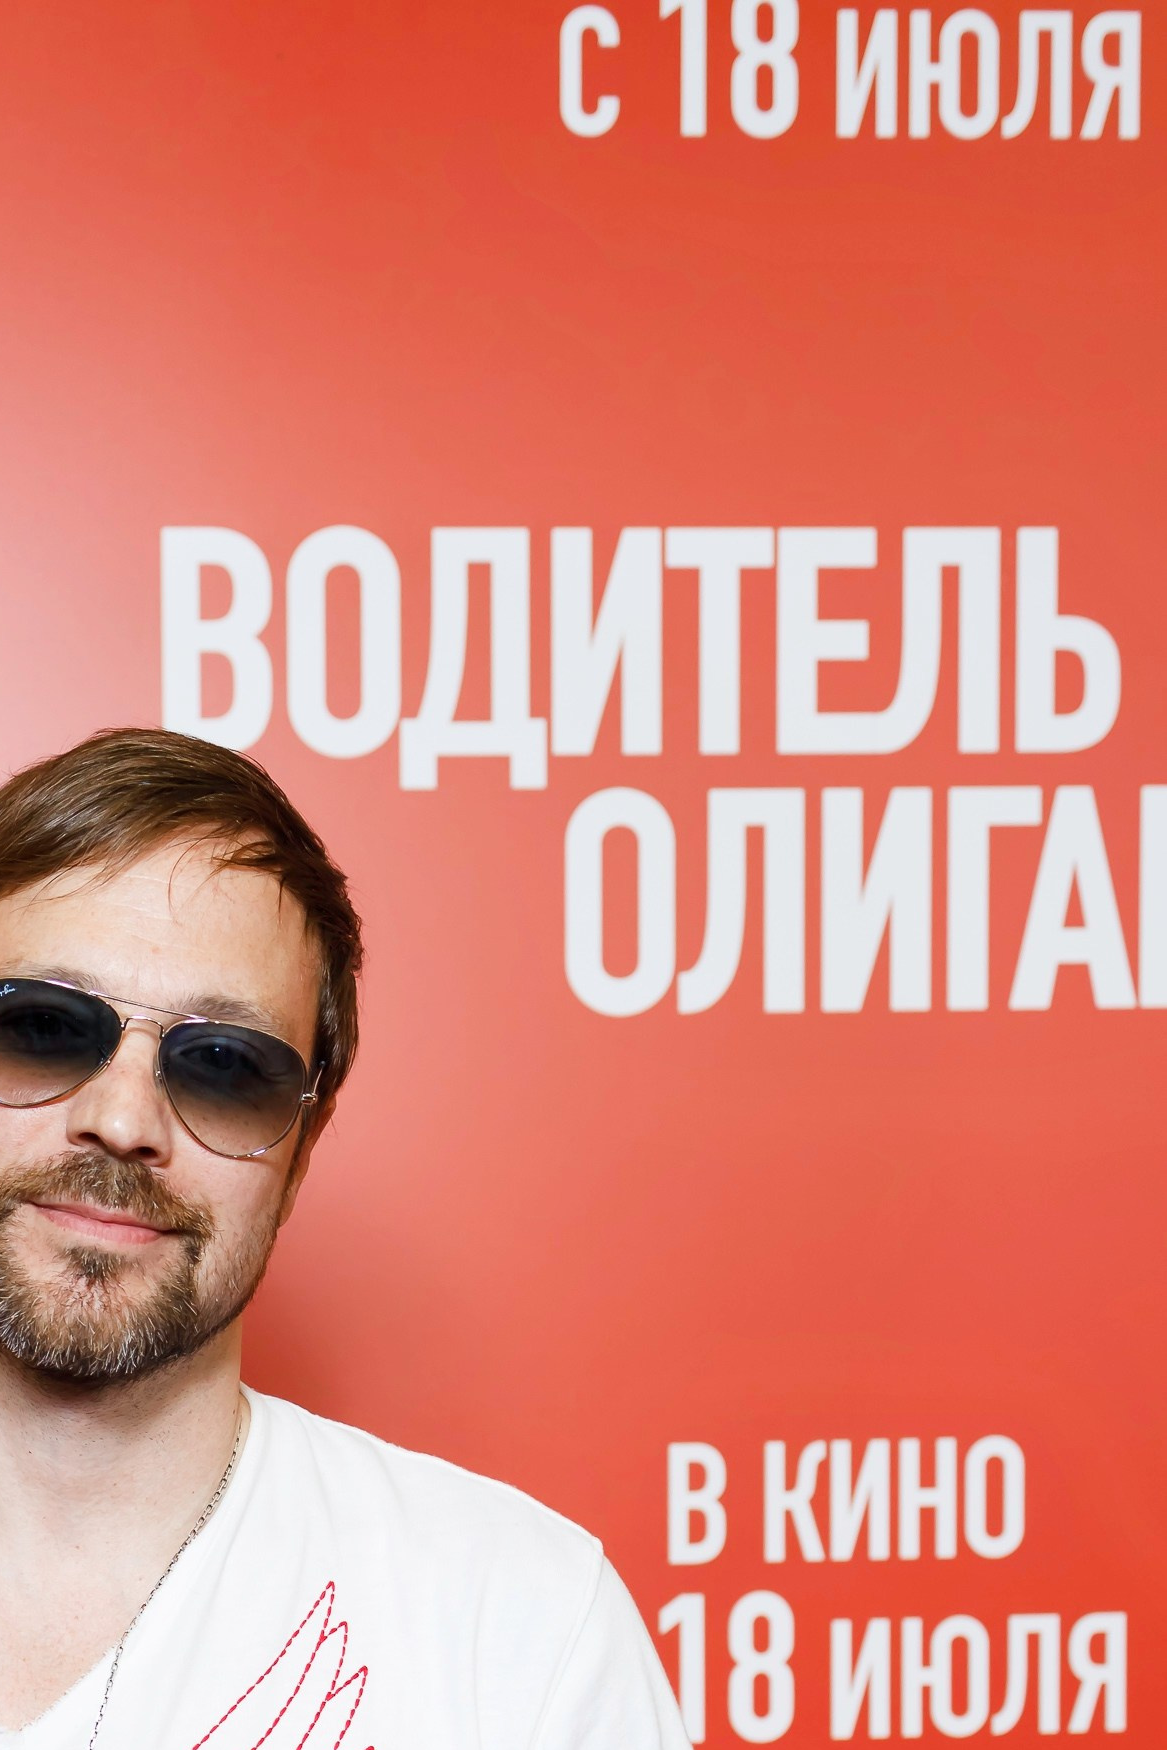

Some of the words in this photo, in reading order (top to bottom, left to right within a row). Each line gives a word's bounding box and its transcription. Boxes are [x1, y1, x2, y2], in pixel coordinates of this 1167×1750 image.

[658, 0, 800, 139] 18
[835, 8, 1142, 141] ИЮЛЯ
[160, 523, 1122, 791] ВОДИТЕЛЬ
[563, 784, 1167, 1018] ОЛИГА
[667, 1441, 727, 1566] В
[764, 1434, 1025, 1564] КИНО
[658, 1589, 795, 1745] 18
[830, 1612, 1128, 1741] ИЮЛЯ
